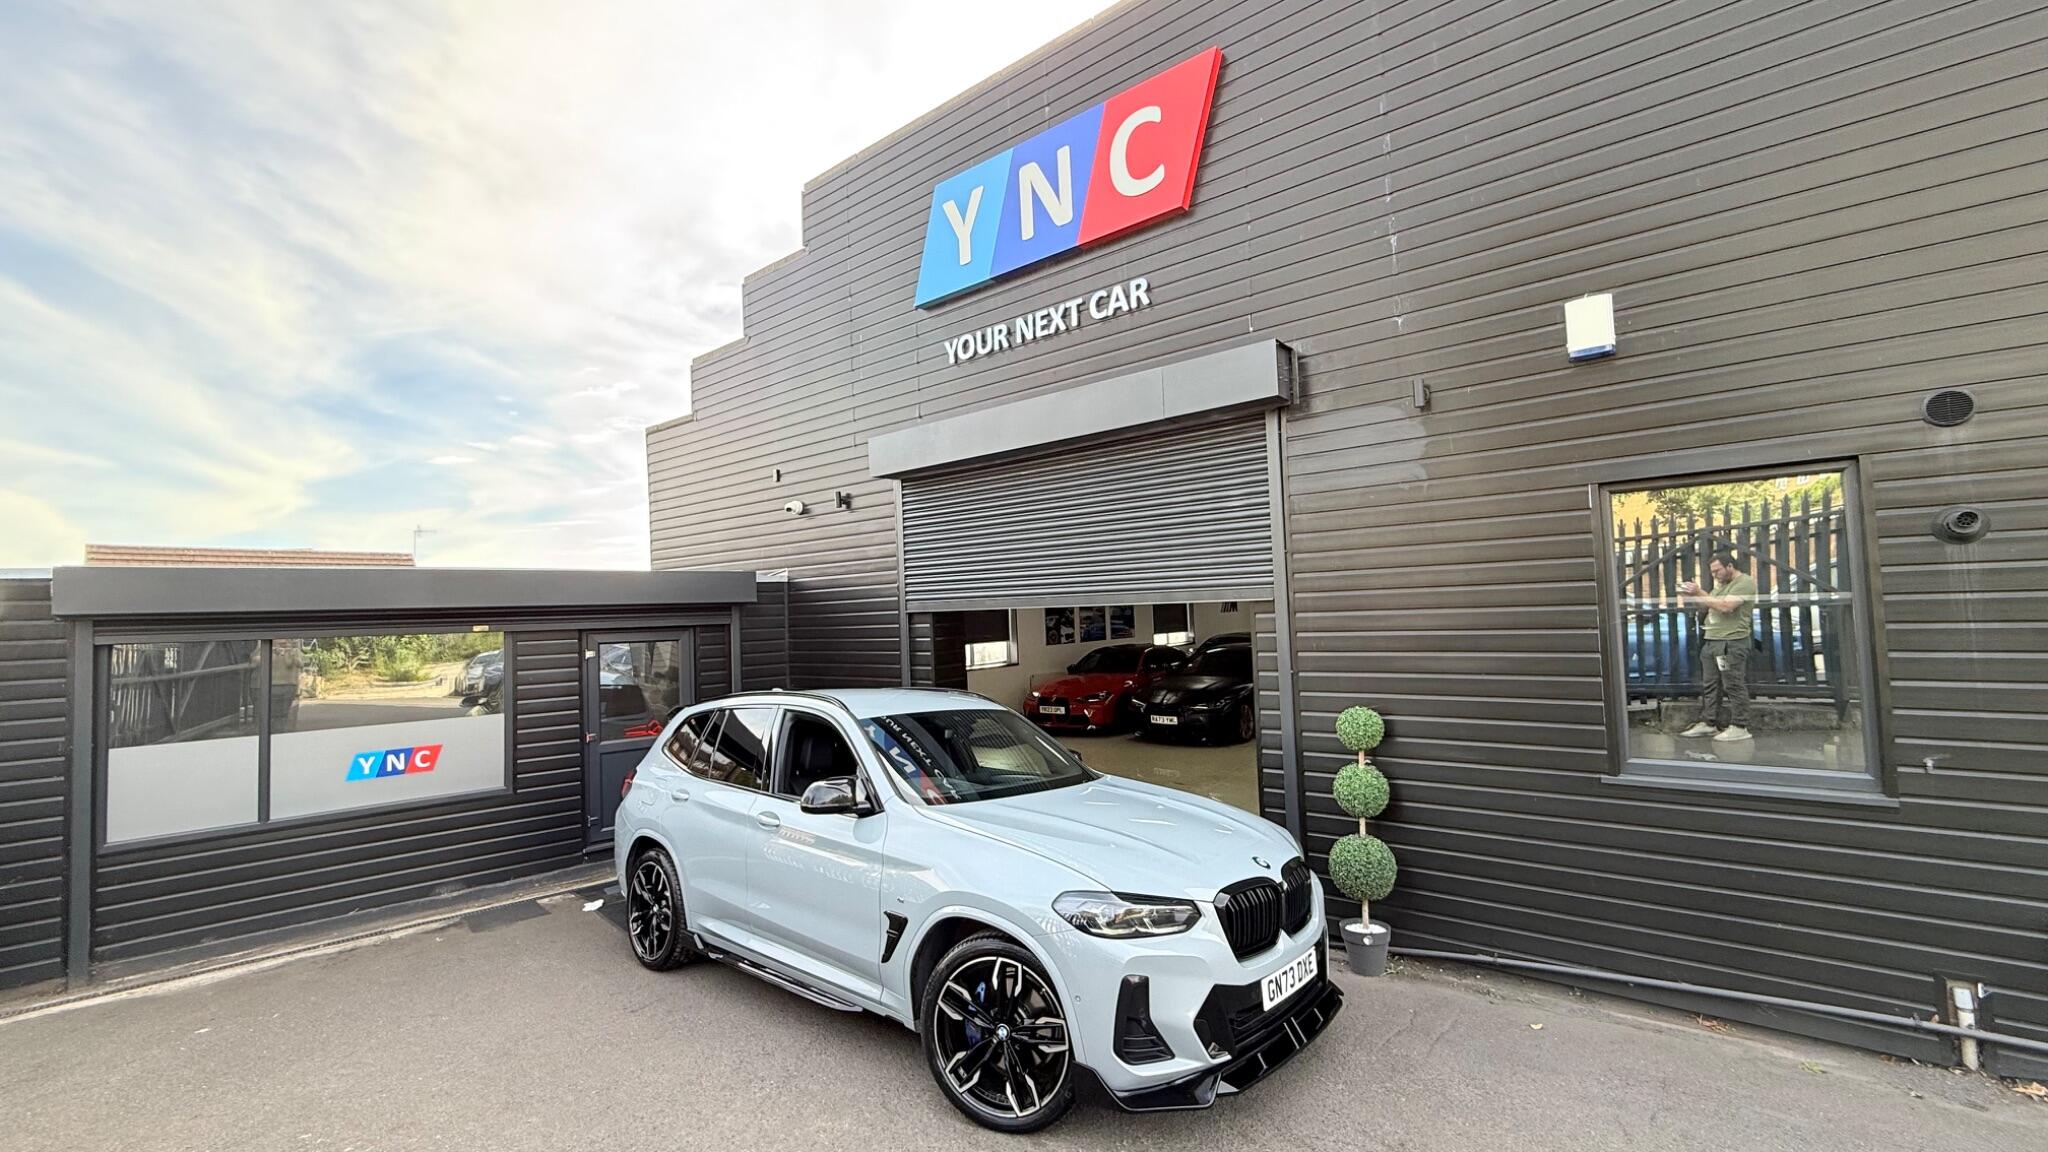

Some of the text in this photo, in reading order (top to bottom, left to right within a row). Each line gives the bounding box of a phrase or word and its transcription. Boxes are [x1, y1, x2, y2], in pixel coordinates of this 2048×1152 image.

[942, 105, 1165, 266] YNC
[944, 276, 1150, 364] YOUR NEXT CAR
[358, 750, 431, 775] YNC
[1267, 952, 1314, 1002] GN73 DXE
